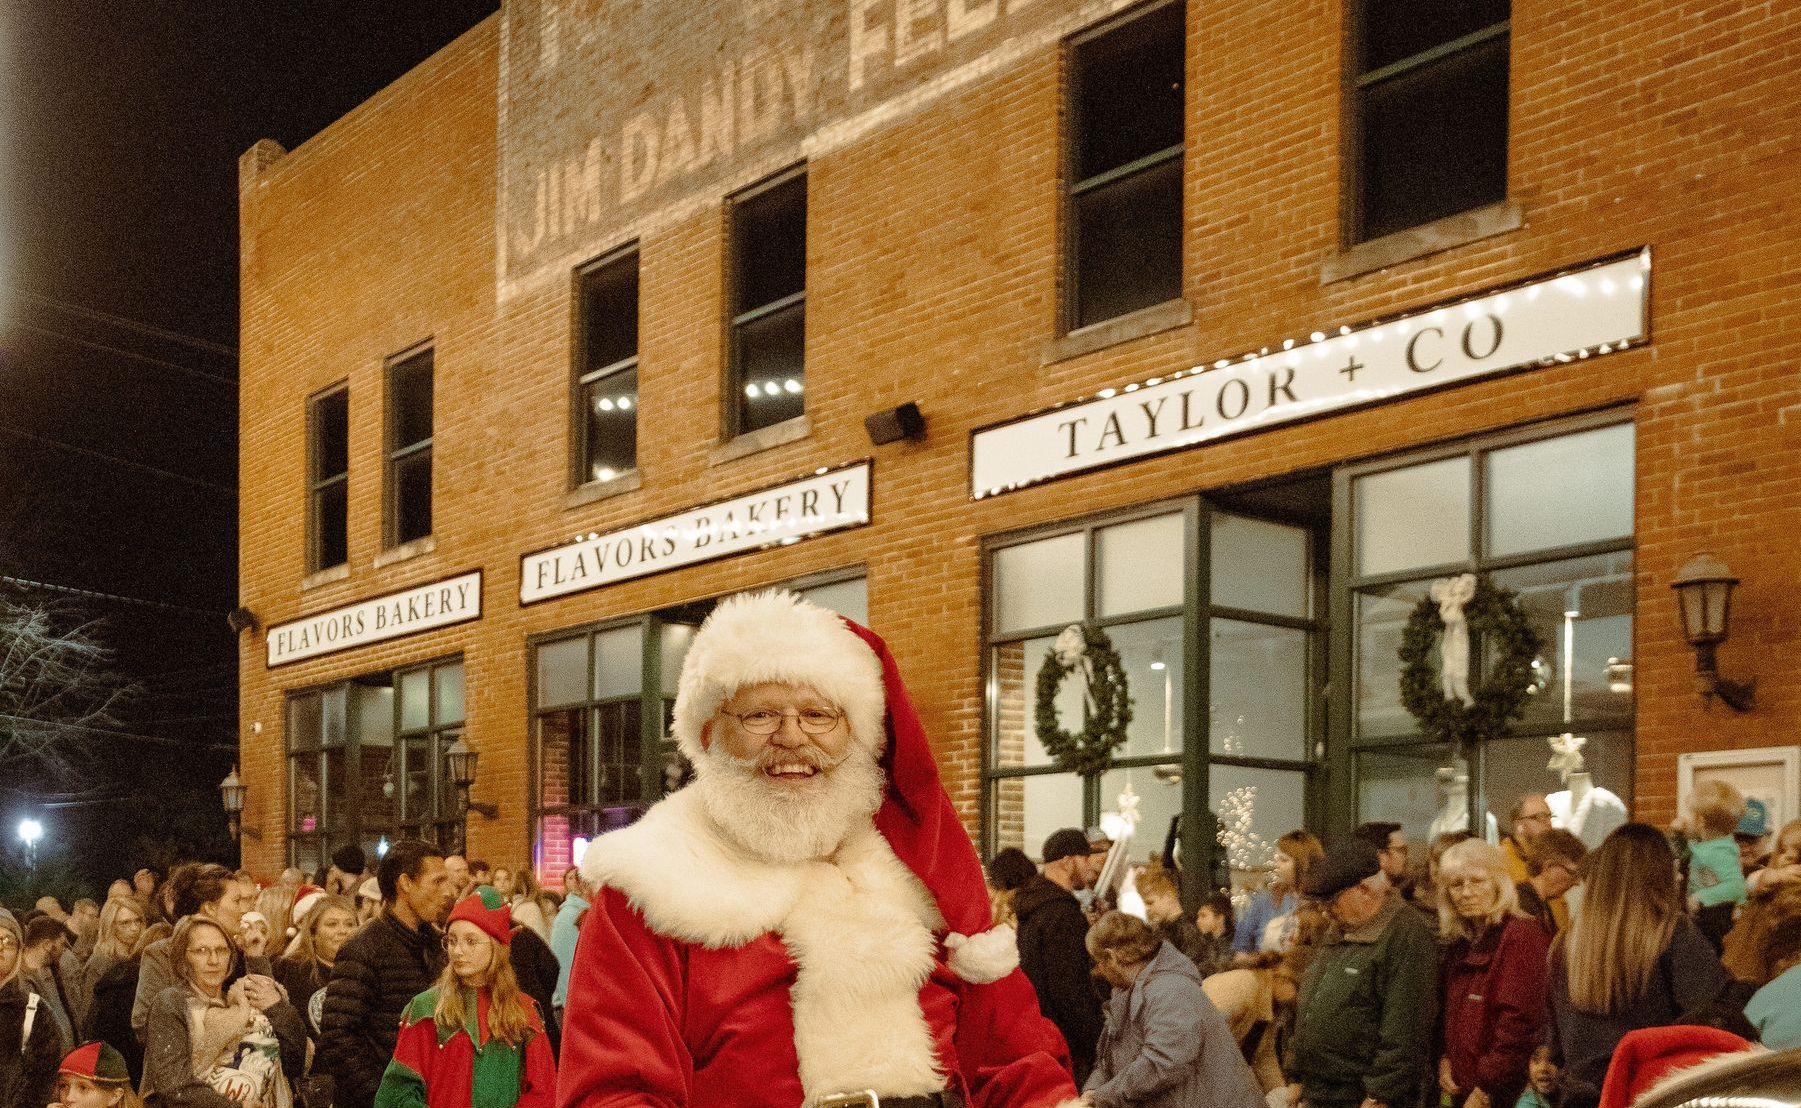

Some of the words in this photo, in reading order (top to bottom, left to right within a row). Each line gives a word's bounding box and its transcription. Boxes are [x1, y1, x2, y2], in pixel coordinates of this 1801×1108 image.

[512, 137, 600, 256] JIM
[621, 44, 820, 204] DANDY
[1058, 366, 1298, 459] TAYLOR
[1339, 354, 1364, 382] +
[1405, 313, 1505, 374] CO
[536, 526, 677, 590] FLAVORS
[693, 479, 851, 549] BAKERY
[277, 610, 365, 656] FLAVORS
[375, 582, 470, 630] BAKERY
